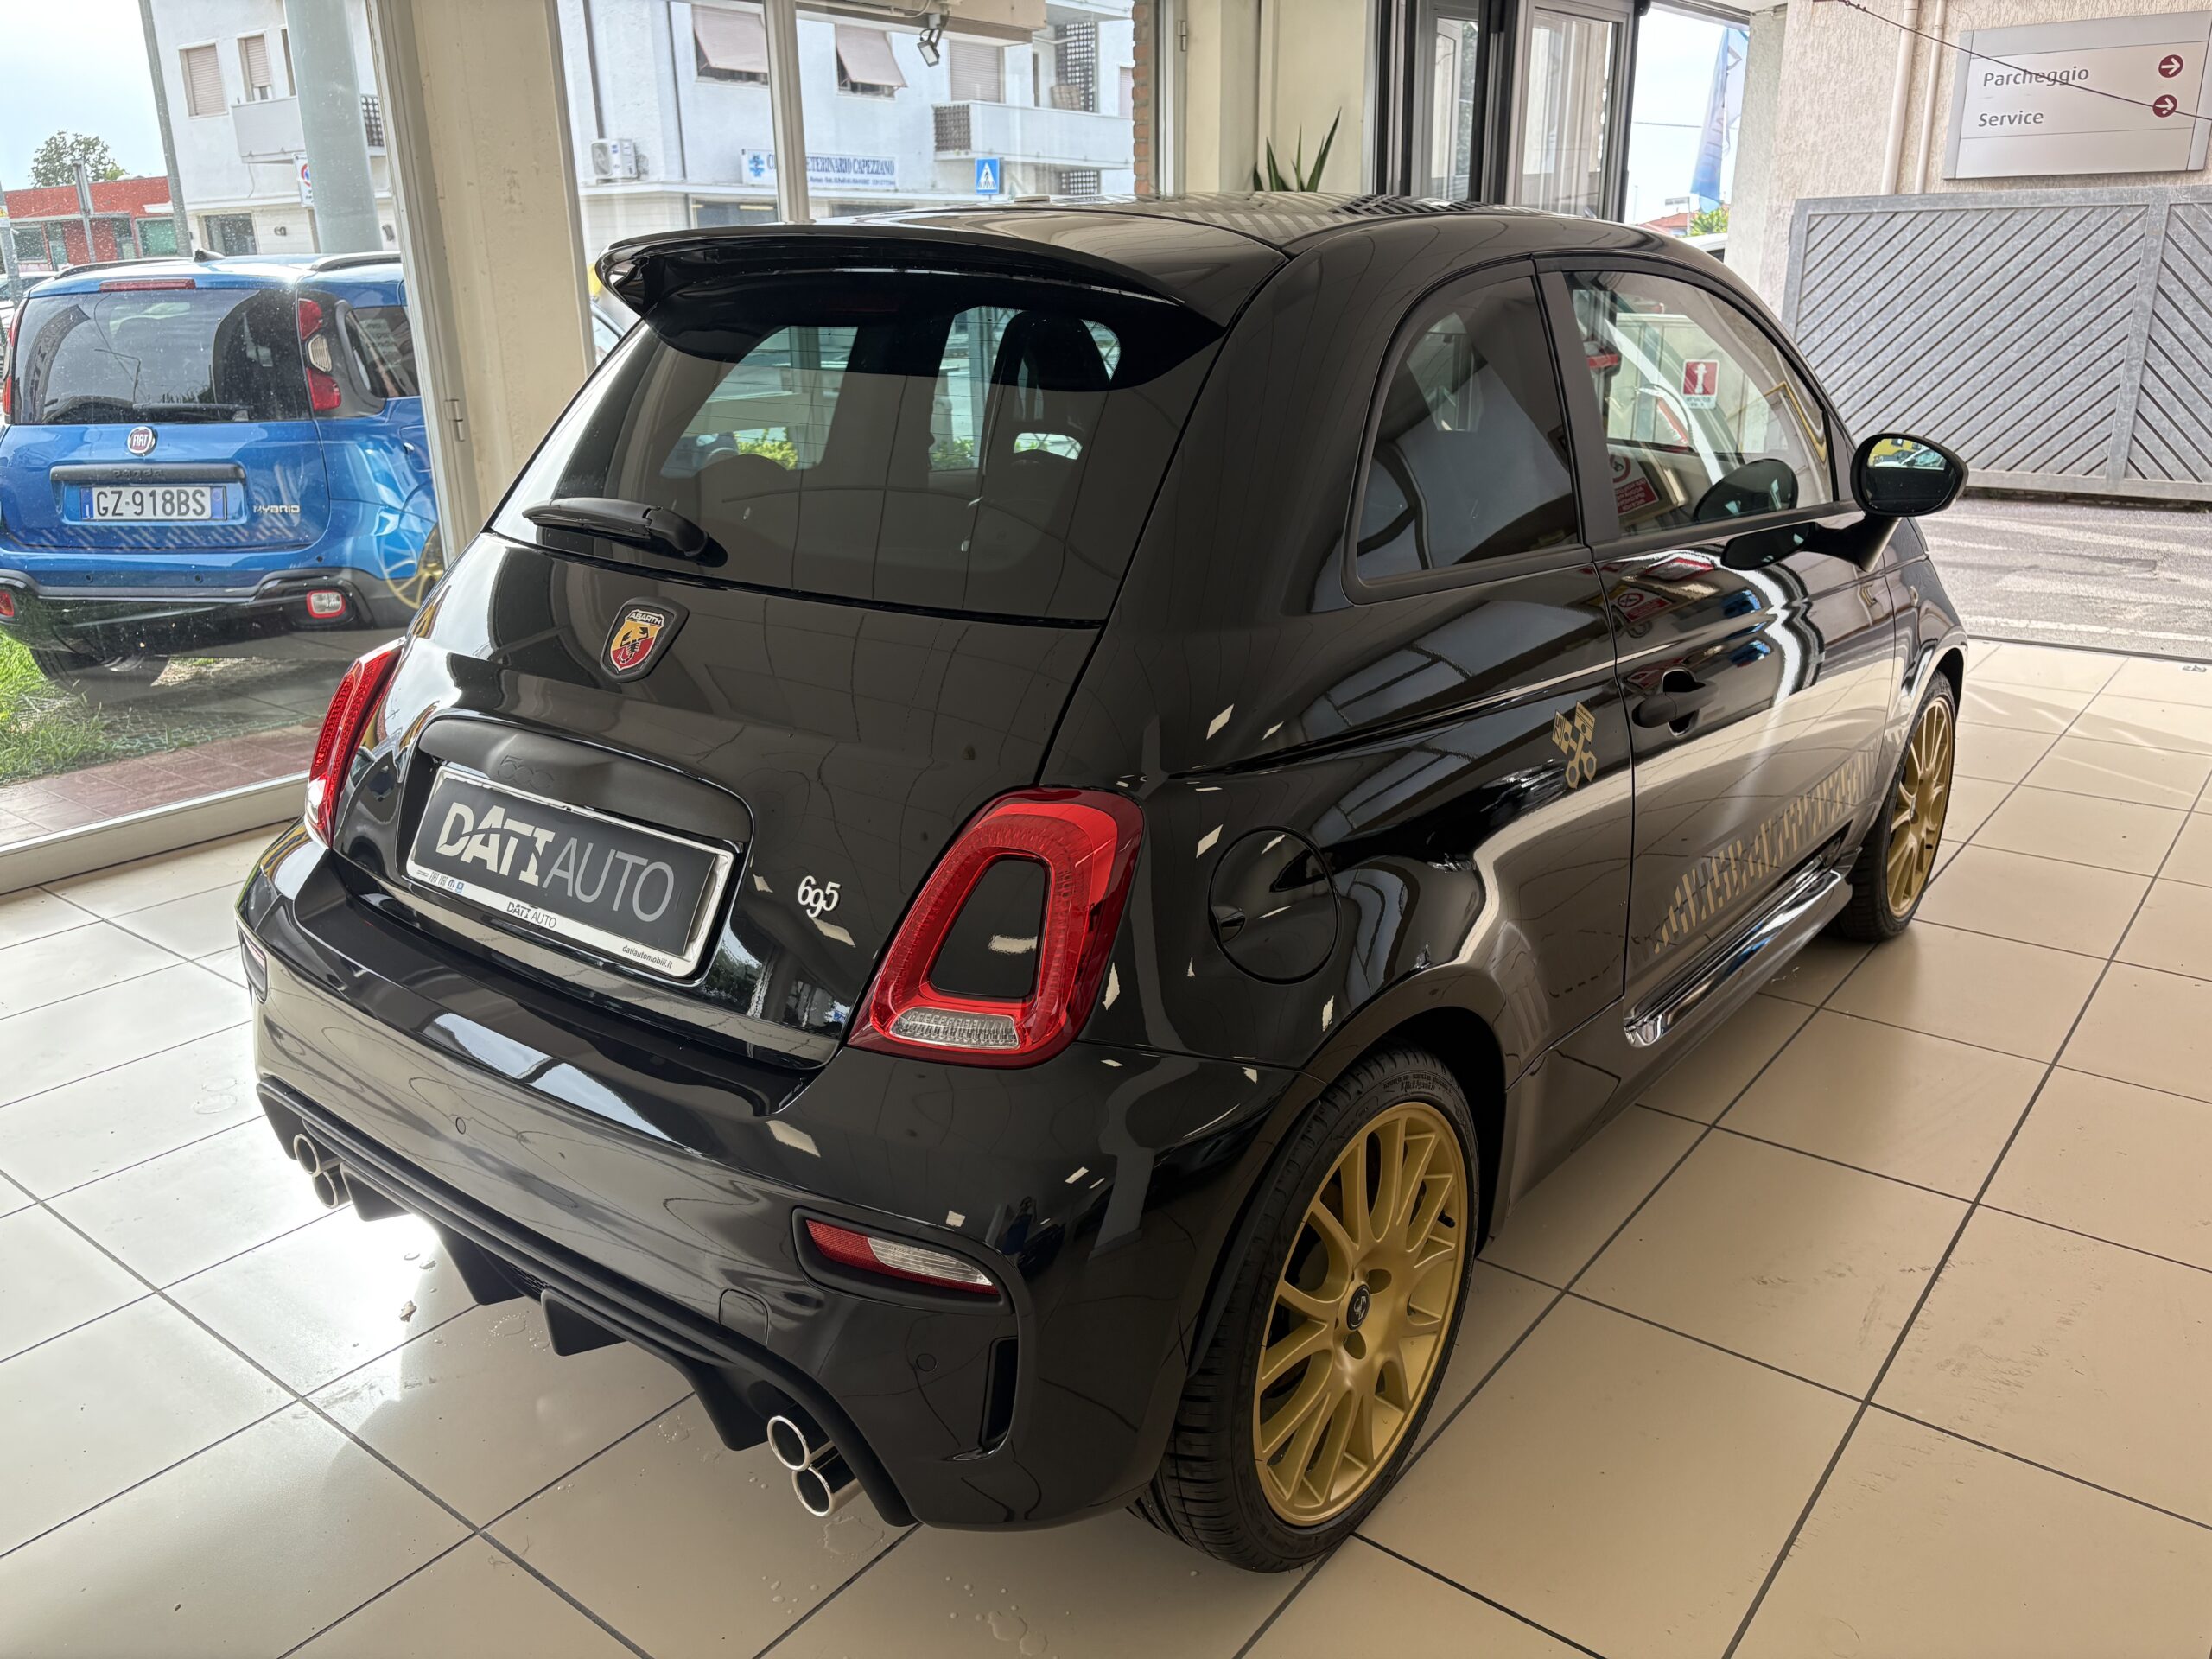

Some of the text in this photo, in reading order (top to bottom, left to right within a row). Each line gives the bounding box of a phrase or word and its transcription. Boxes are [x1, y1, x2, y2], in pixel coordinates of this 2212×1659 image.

[1983, 66, 2089, 87] Parcheggio
[1978, 111, 2044, 127] Service
[806, 156, 895, 175] ETERINARIO CAPEZZANO
[132, 434, 149, 447] FIAT
[253, 505, 300, 513] HYBRID
[629, 612, 662, 625] ABARTH
[435, 802, 675, 922] DATI AUTO
[798, 875, 842, 918] 695
[507, 901, 557, 929] DATI AUTO
[622, 944, 673, 969] datiautomobili.it
